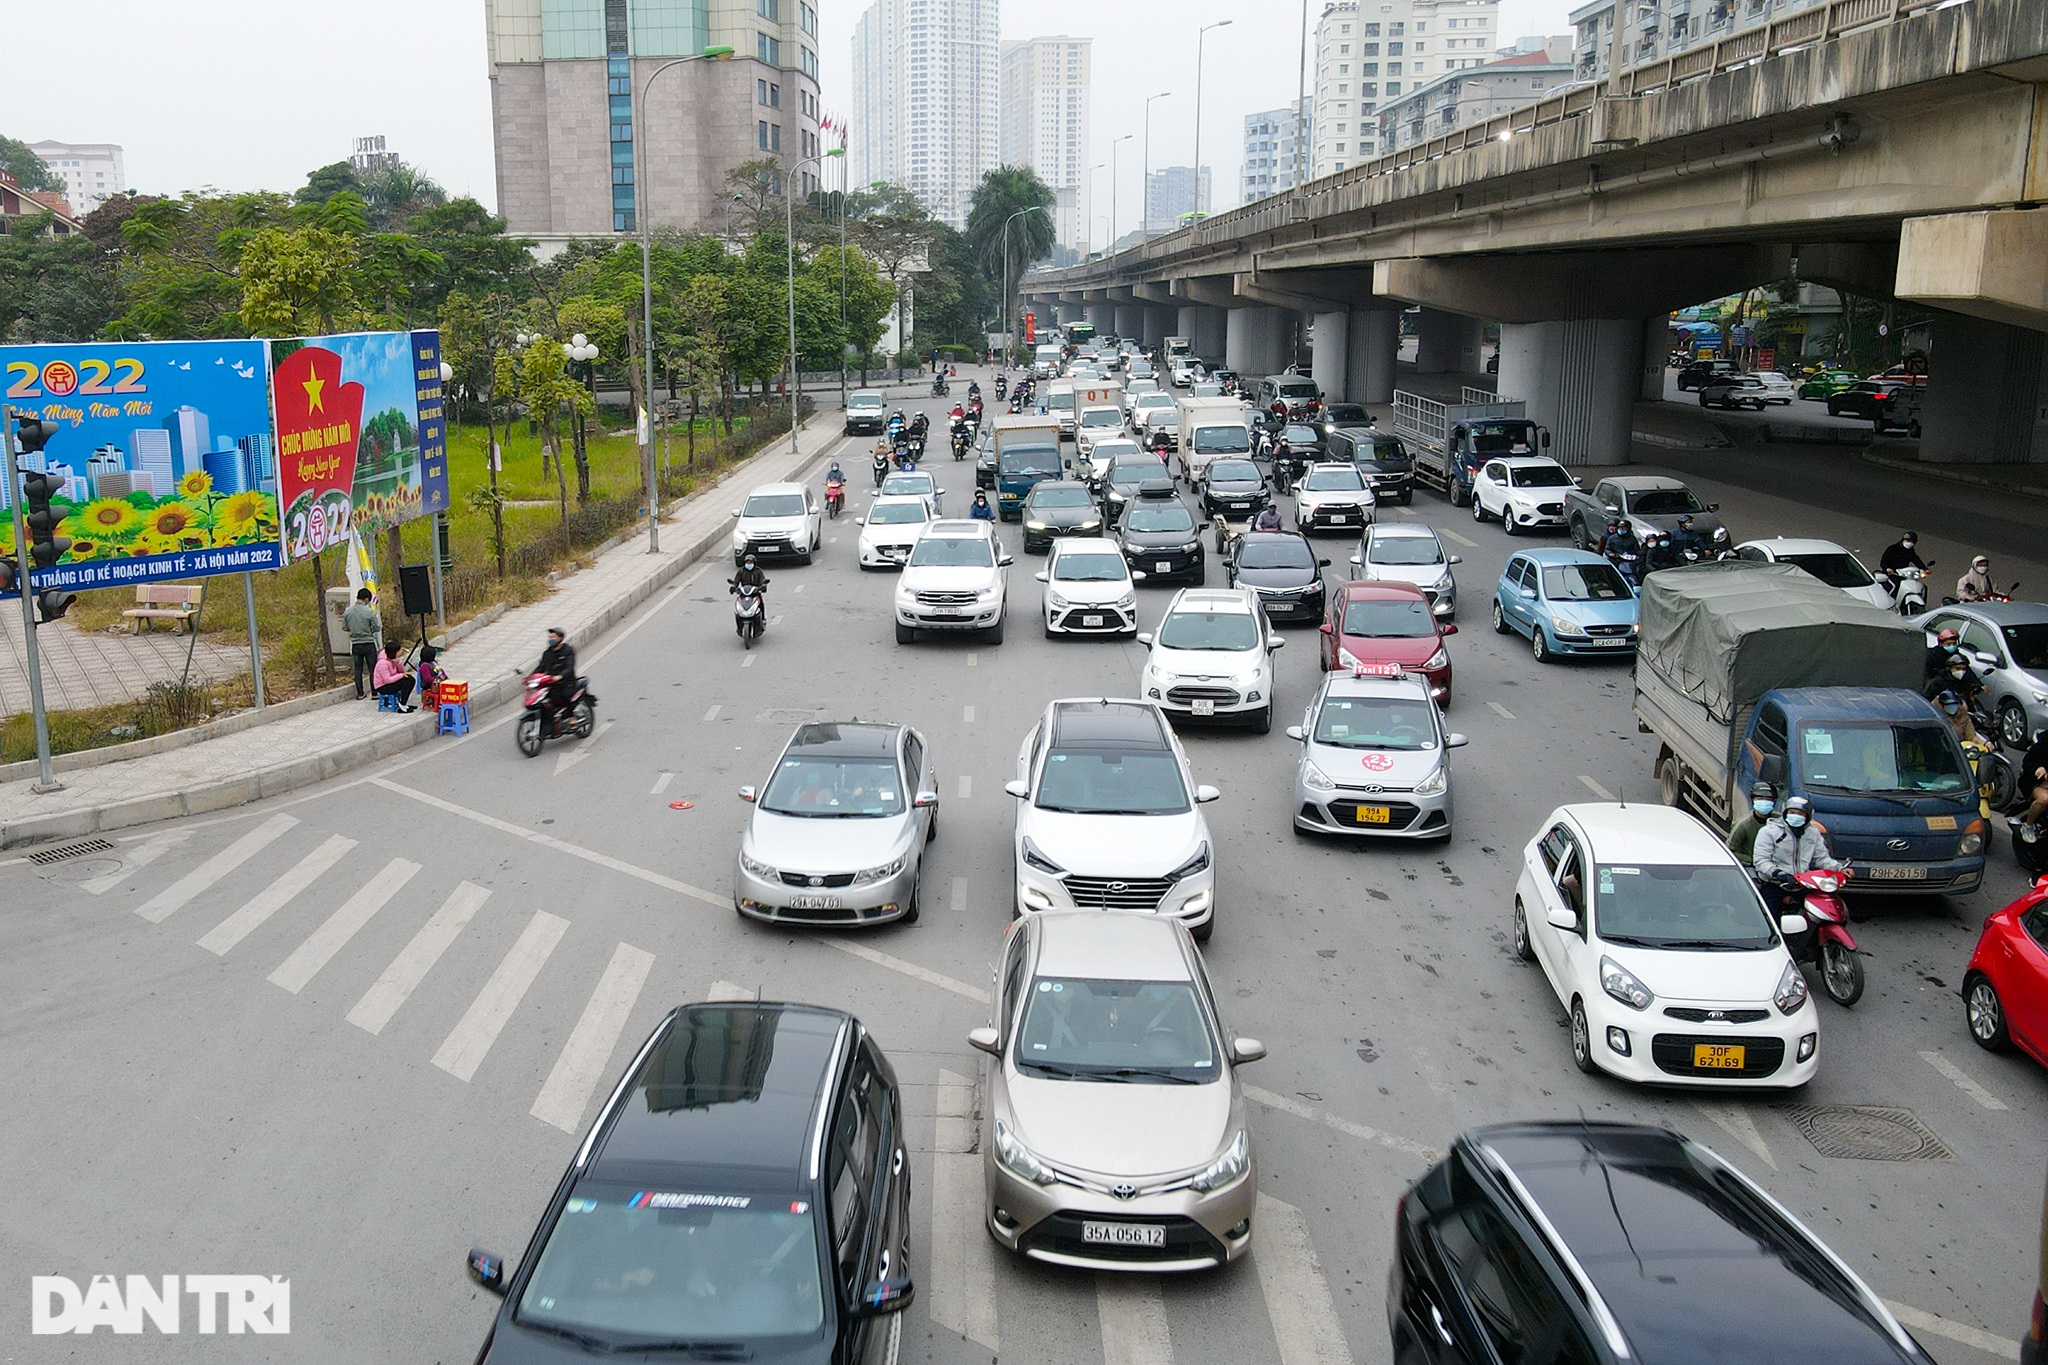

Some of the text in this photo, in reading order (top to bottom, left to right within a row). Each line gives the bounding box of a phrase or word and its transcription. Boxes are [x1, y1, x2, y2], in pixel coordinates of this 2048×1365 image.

[42, 403, 84, 428] Mừng
[89, 401, 120, 418] Năm
[124, 400, 153, 416] Mới
[281, 419, 352, 456] CHÚC MỪNG NĂM MỚI
[298, 457, 321, 482] Happy
[316, 455, 328, 473] New
[42, 569, 76, 587] THẮNG
[79, 569, 95, 584] LỢI
[97, 563, 111, 580] KẾ
[113, 563, 146, 580] HOẠCH
[148, 561, 172, 575] KINH
[174, 554, 186, 572] TẾ
[194, 555, 208, 570] XÃ
[209, 553, 225, 569] HỘI
[227, 551, 249, 566] NĂM
[250, 549, 273, 564] 2022
[1357, 665, 1399, 675] Taxi 123
[1366, 807, 1380, 815] 99A
[1709, 1047, 1731, 1056] 30F
[1699, 1057, 1739, 1067] 621.69
